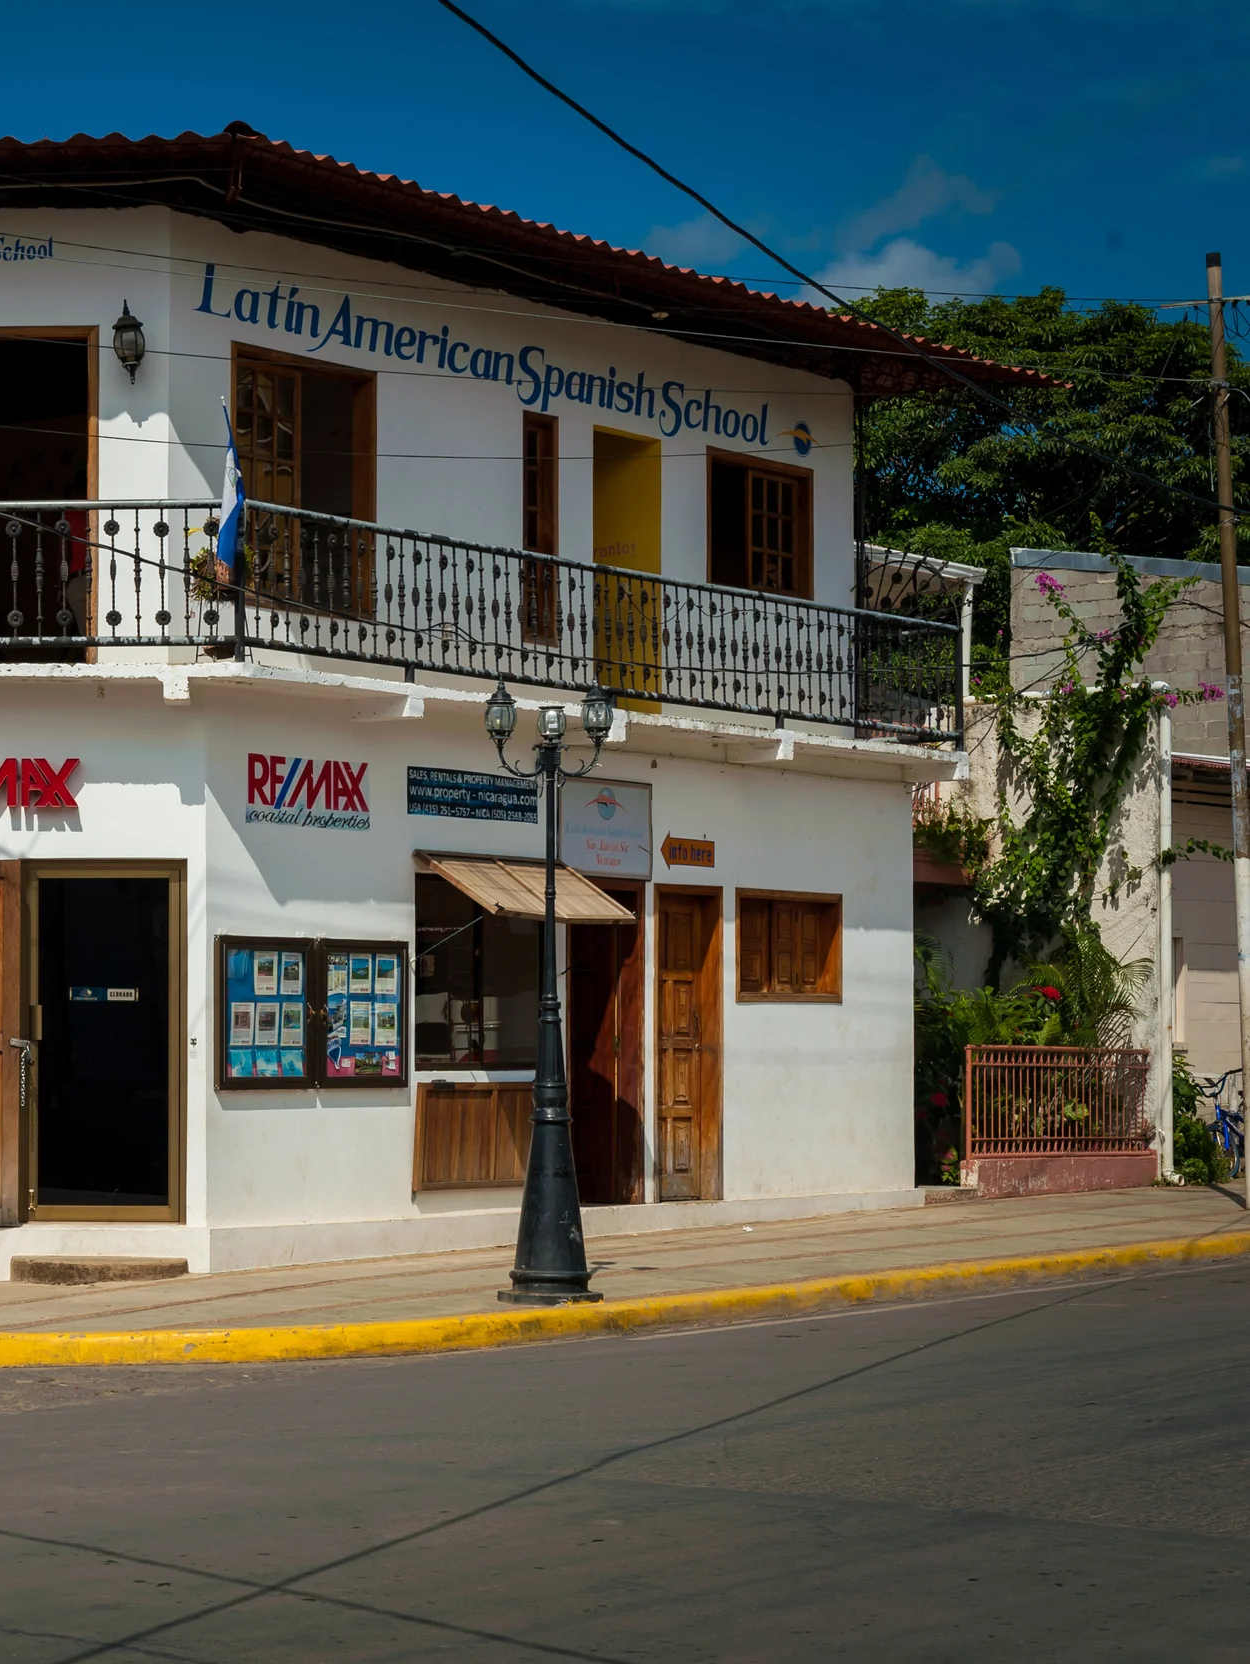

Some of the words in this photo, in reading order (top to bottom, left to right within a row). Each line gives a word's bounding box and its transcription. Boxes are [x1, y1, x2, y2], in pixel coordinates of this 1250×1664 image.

[306, 293, 514, 385] American
[516, 345, 655, 418] Spanish
[659, 380, 770, 446] School
[247, 752, 370, 812] RE/MAX
[408, 769, 428, 781] SALES,
[430, 771, 457, 783] RENTALS
[457, 773, 463, 784] &
[463, 774, 494, 786] PROPERTY
[249, 808, 303, 825] coastal
[302, 812, 371, 830] properties
[409, 802, 421, 813] USA
[422, 803, 438, 814] (415)
[476, 808, 491, 819] NICA
[669, 843, 688, 859] info
[690, 845, 712, 862] here
